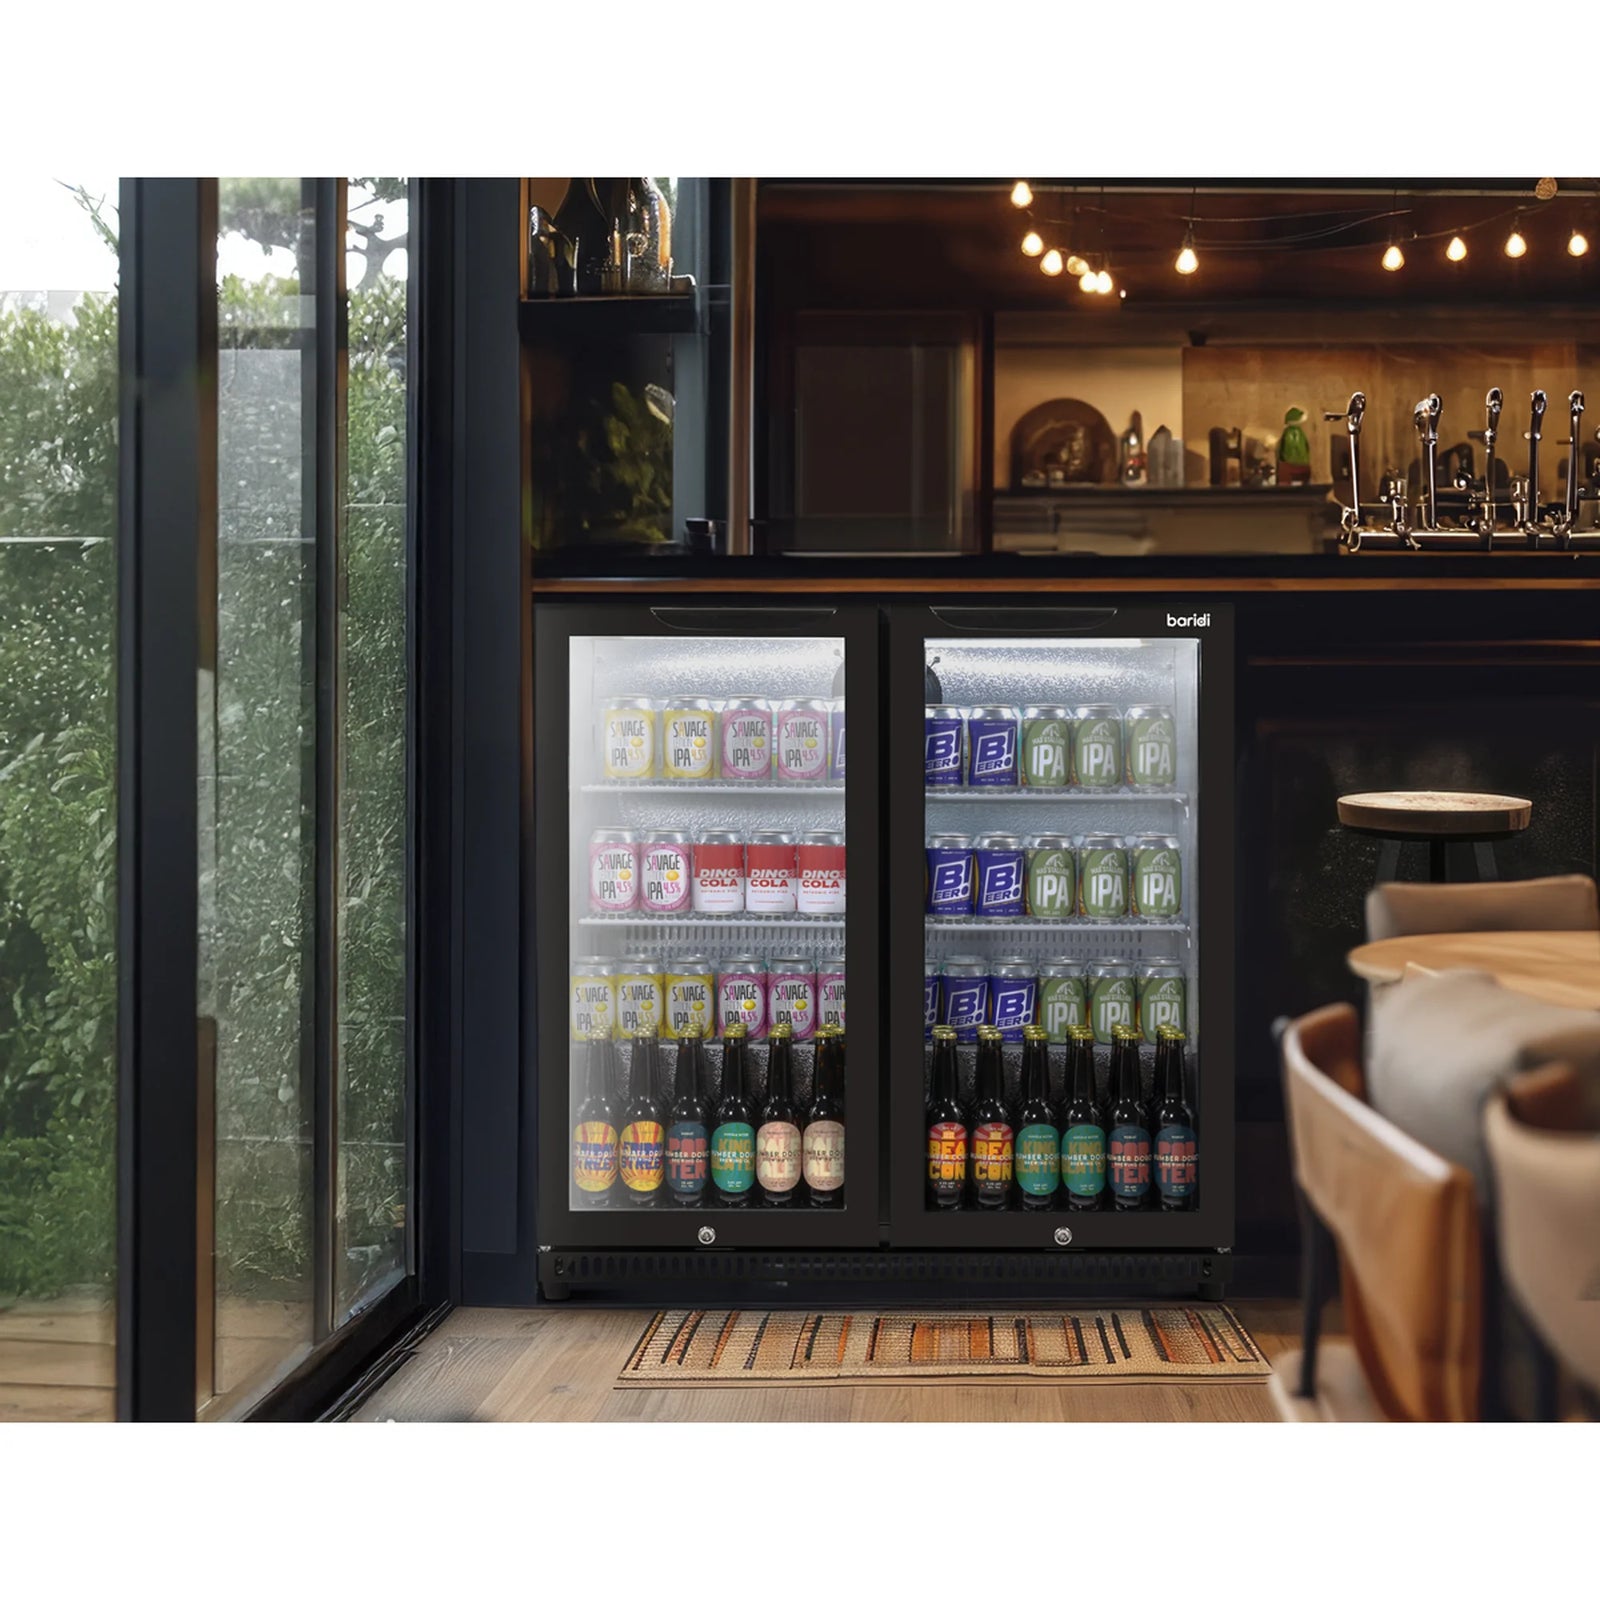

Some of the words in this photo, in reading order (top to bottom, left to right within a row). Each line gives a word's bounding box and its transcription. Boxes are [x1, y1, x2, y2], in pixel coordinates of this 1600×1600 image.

[1167, 613, 1210, 627] baridi
[610, 720, 645, 737] SAVAGE
[673, 720, 707, 737] SAVAGE
[732, 720, 766, 738] SAVAGE
[784, 721, 818, 738] SAVAGE
[611, 748, 628, 766] IPA
[673, 748, 691, 767] IPA
[732, 748, 750, 767] IPA
[785, 749, 802, 767] IPA
[1032, 744, 1065, 778] IPA
[1083, 743, 1115, 777] IPA
[1139, 743, 1171, 776] IPA
[599, 853, 632, 870] SAVAGE
[646, 854, 680, 871] SAVAGE
[700, 868, 738, 878] DINO
[750, 869, 788, 878] DINO
[802, 870, 840, 879] DINO
[599, 881, 616, 899] IPA
[647, 881, 664, 900] IPA
[700, 879, 738, 887] COLA
[750, 880, 788, 888] COLA
[802, 880, 840, 888] COLA
[1036, 874, 1069, 908] IPA
[1091, 873, 1124, 907] IPA
[1143, 873, 1176, 907] IPA
[575, 985, 608, 1002] SAVAGE
[621, 984, 654, 1001] SAVAGE
[672, 985, 705, 1001] SAVAGE
[724, 983, 757, 1000] SAVAGE
[775, 983, 808, 1000] SAVAGE
[824, 984, 845, 1000] SAVA
[576, 1011, 592, 1031] IPA
[622, 1011, 638, 1029] IPA
[673, 1012, 689, 1030] IPA
[725, 1011, 740, 1026] IPA
[776, 1011, 792, 1025] IPA
[824, 1011, 840, 1025] IPA
[1047, 1002, 1079, 1034] IPA
[1100, 1002, 1130, 1033] IPA
[1150, 1002, 1180, 1031] IPA
[718, 1139, 752, 1152] KING
[929, 1140, 966, 1157] BEA
[975, 1140, 1012, 1157] BEA
[668, 1159, 706, 1179] TER
[929, 1162, 965, 1180] CON
[975, 1162, 1012, 1180] CON
[1111, 1162, 1149, 1184] TER
[1159, 1162, 1195, 1184] TER
